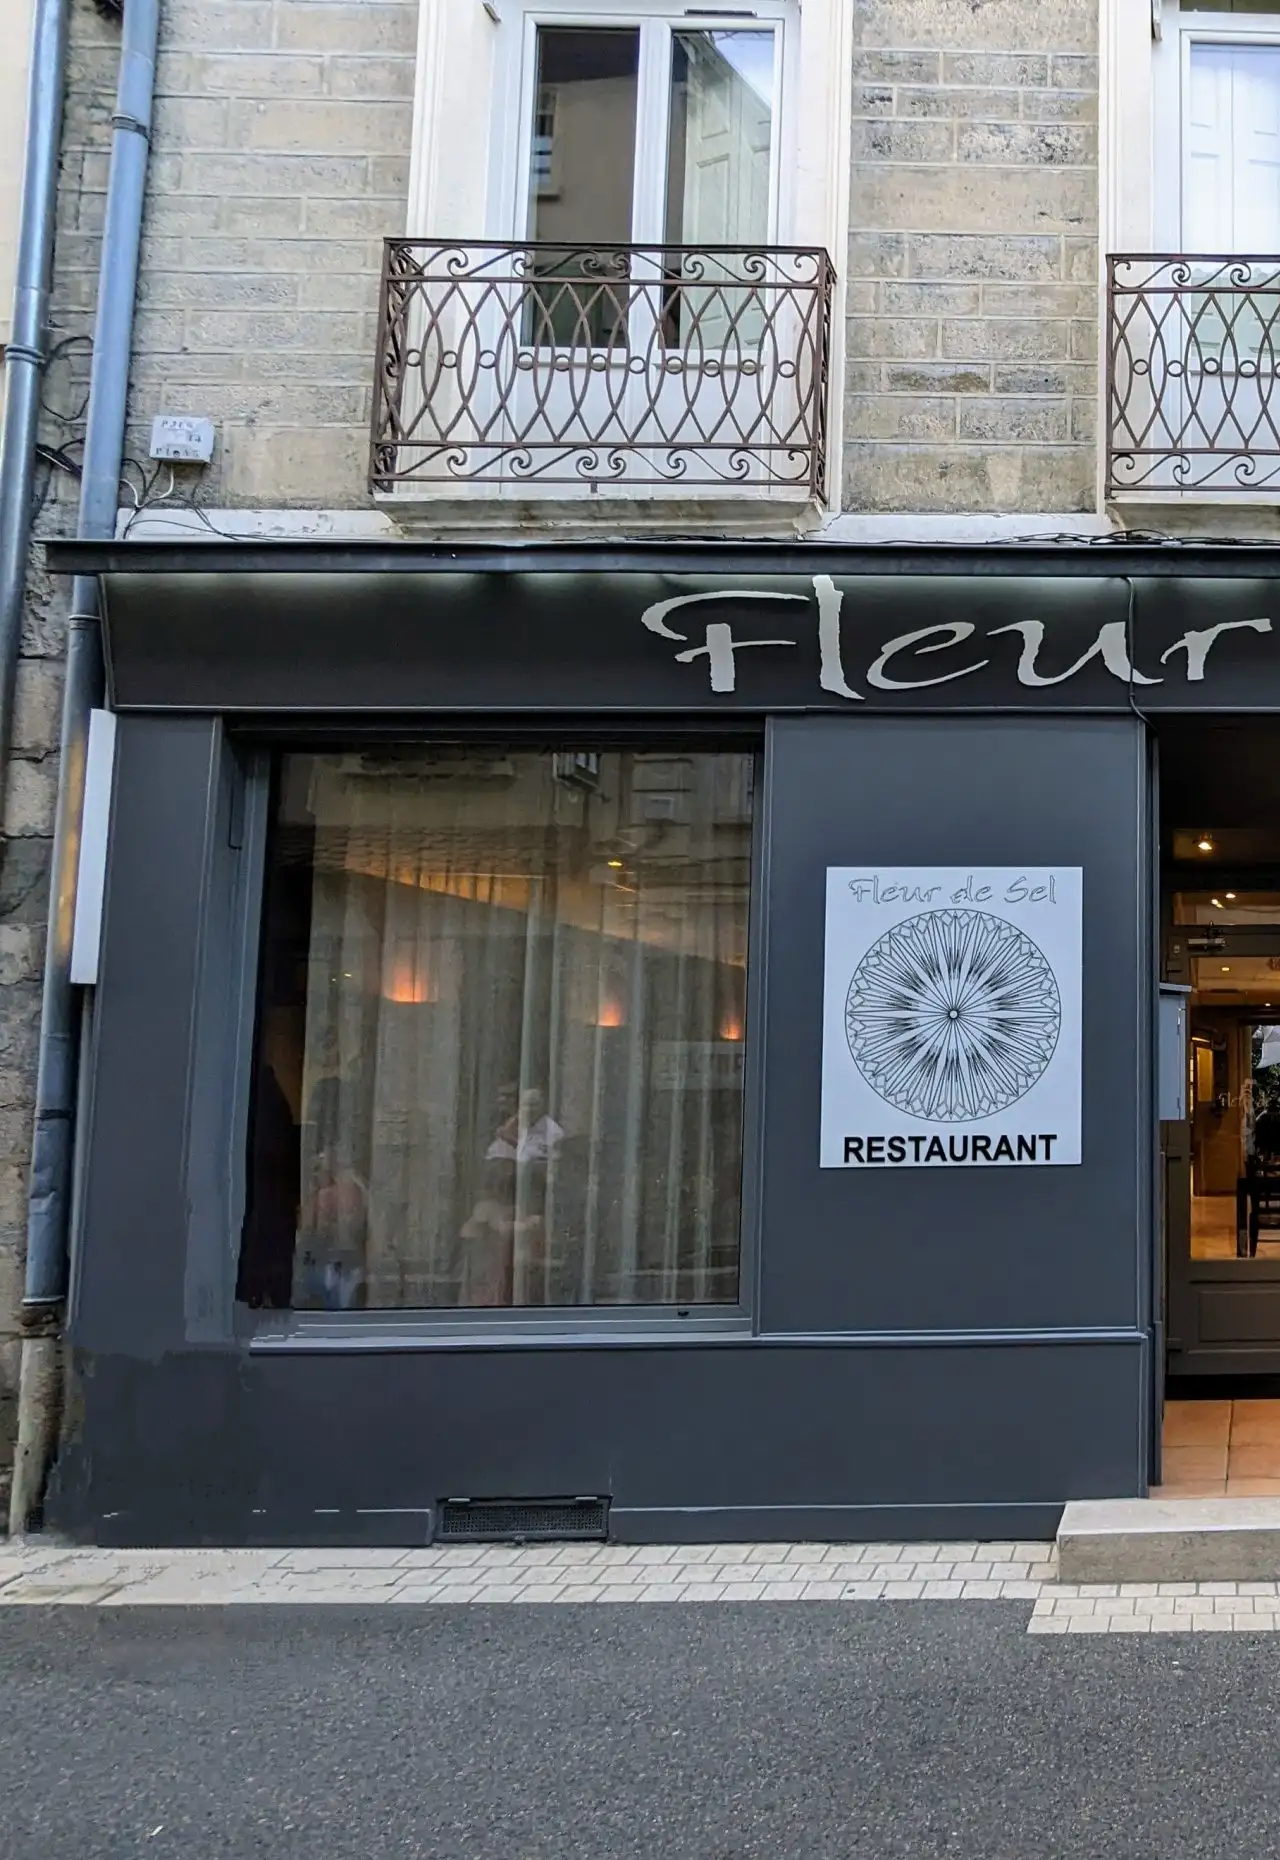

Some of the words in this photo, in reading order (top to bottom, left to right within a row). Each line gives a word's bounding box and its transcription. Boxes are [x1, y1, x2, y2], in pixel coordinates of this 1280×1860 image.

[641, 574, 1271, 700] Fleur
[847, 875, 942, 904] Fleur
[949, 875, 993, 904] de
[1003, 875, 1057, 904] Sel
[843, 1134, 1058, 1163] RESTAURANT
